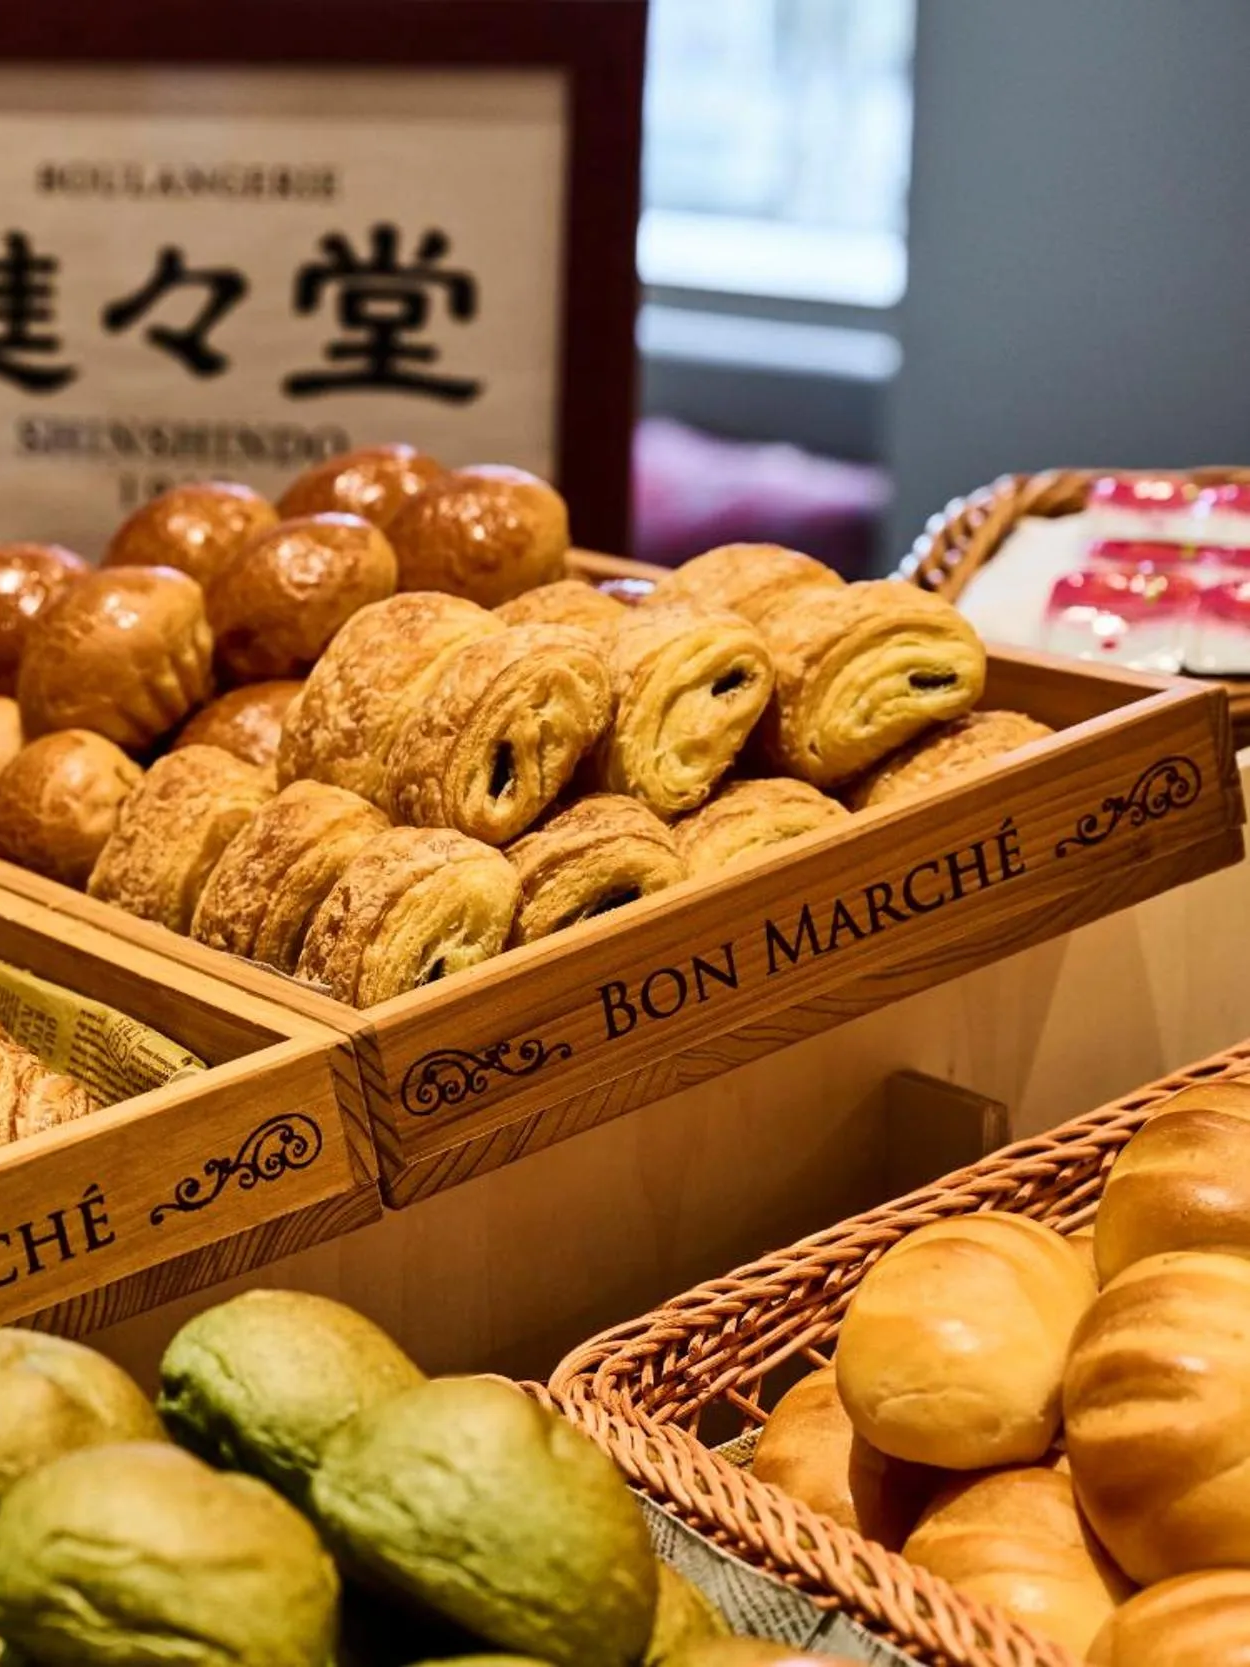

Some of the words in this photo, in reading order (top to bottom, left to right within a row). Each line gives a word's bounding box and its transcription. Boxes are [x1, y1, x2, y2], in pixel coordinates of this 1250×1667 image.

[37, 162, 338, 200] BOULANGERIE
[596, 942, 740, 1040] BON
[765, 817, 1026, 976] MARCHÉ
